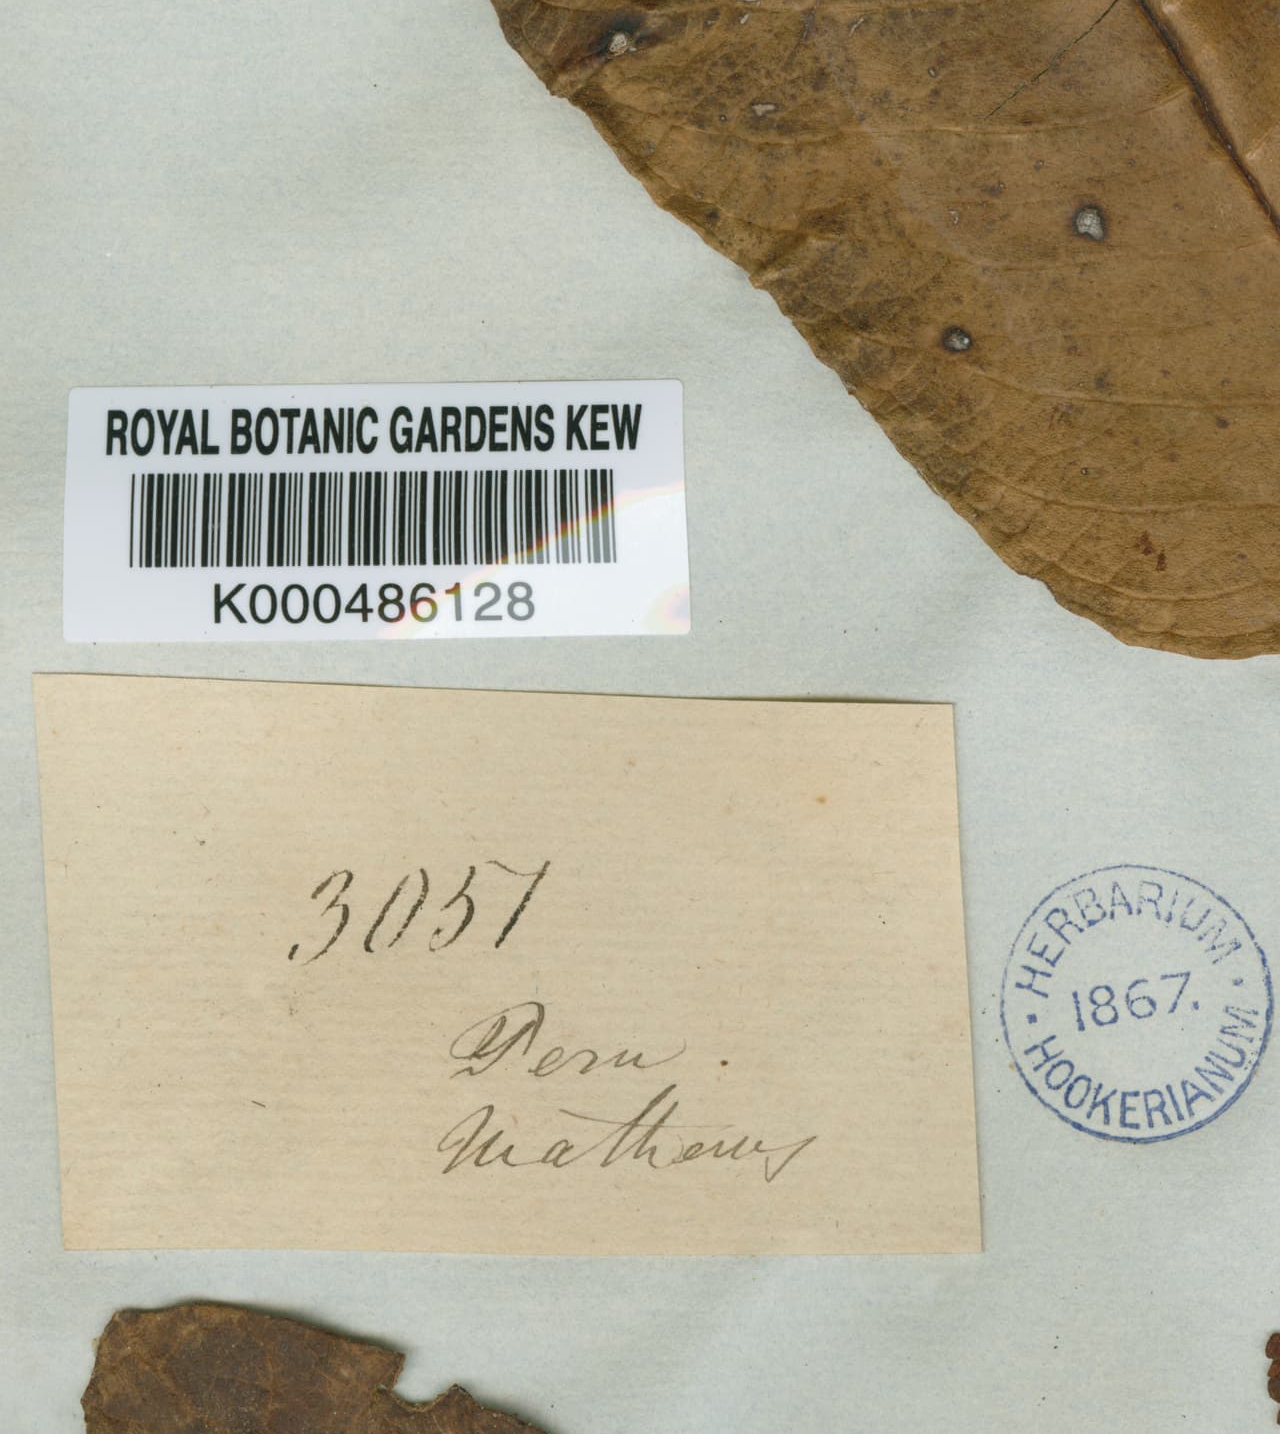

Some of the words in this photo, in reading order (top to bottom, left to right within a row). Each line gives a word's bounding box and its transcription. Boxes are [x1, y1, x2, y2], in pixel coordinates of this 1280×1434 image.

[105, 408, 220, 456] ROYAL
[229, 407, 378, 455] BOTANIC
[389, 404, 555, 454] GARDENS
[564, 403, 642, 451] KEW
[212, 581, 535, 624] K000486128
[1015, 881, 1242, 998] HERBARIUM
[1024, 1005, 1259, 1129] HOOKERIANUM
